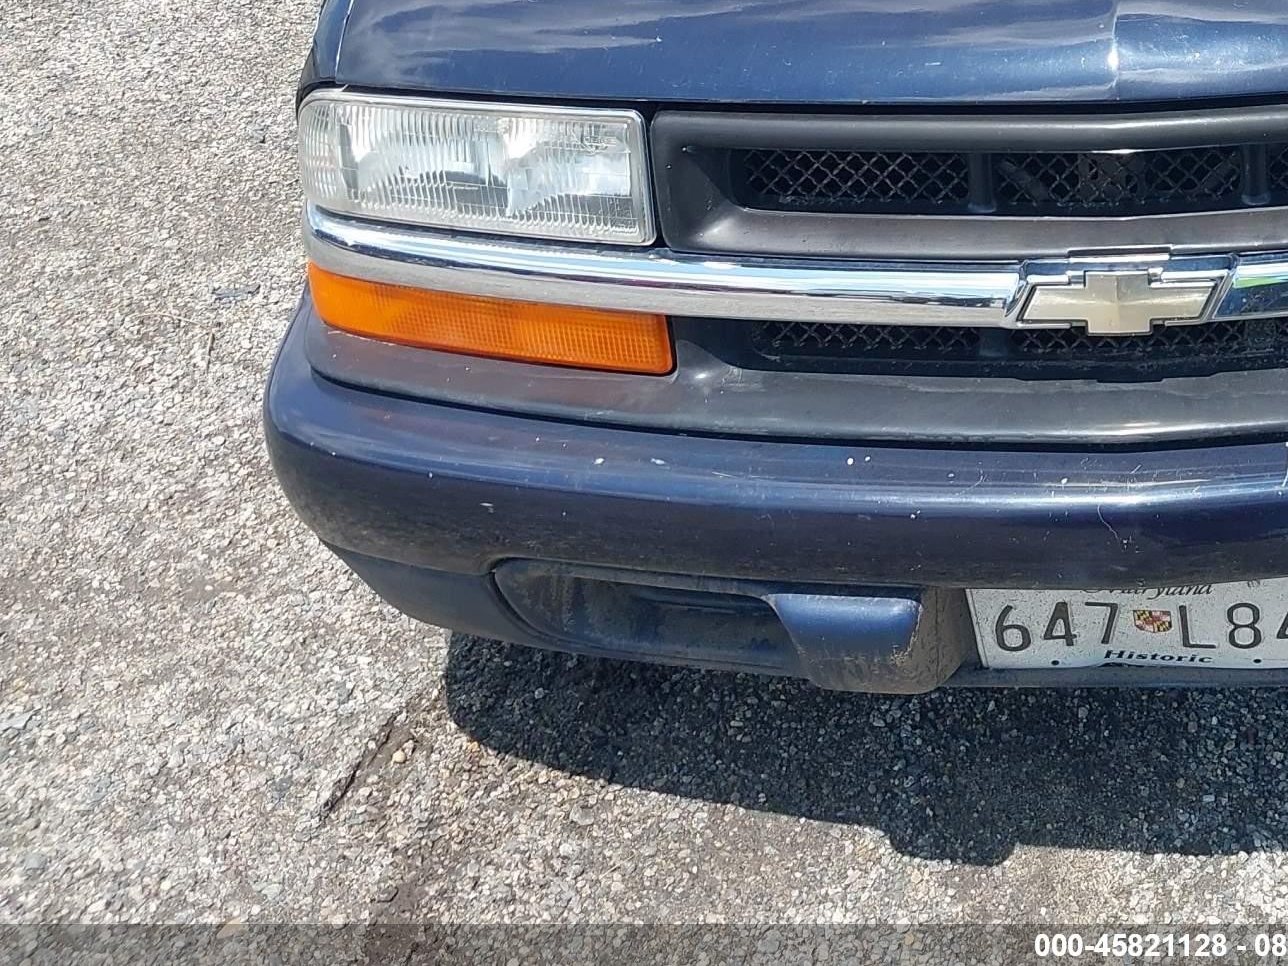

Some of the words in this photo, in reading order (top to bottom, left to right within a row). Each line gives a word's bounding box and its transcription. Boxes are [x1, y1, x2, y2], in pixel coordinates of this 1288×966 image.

[1081, 583, 1213, 600] ryand
[994, 600, 1120, 653] 647
[1103, 649, 1213, 664] Historic
